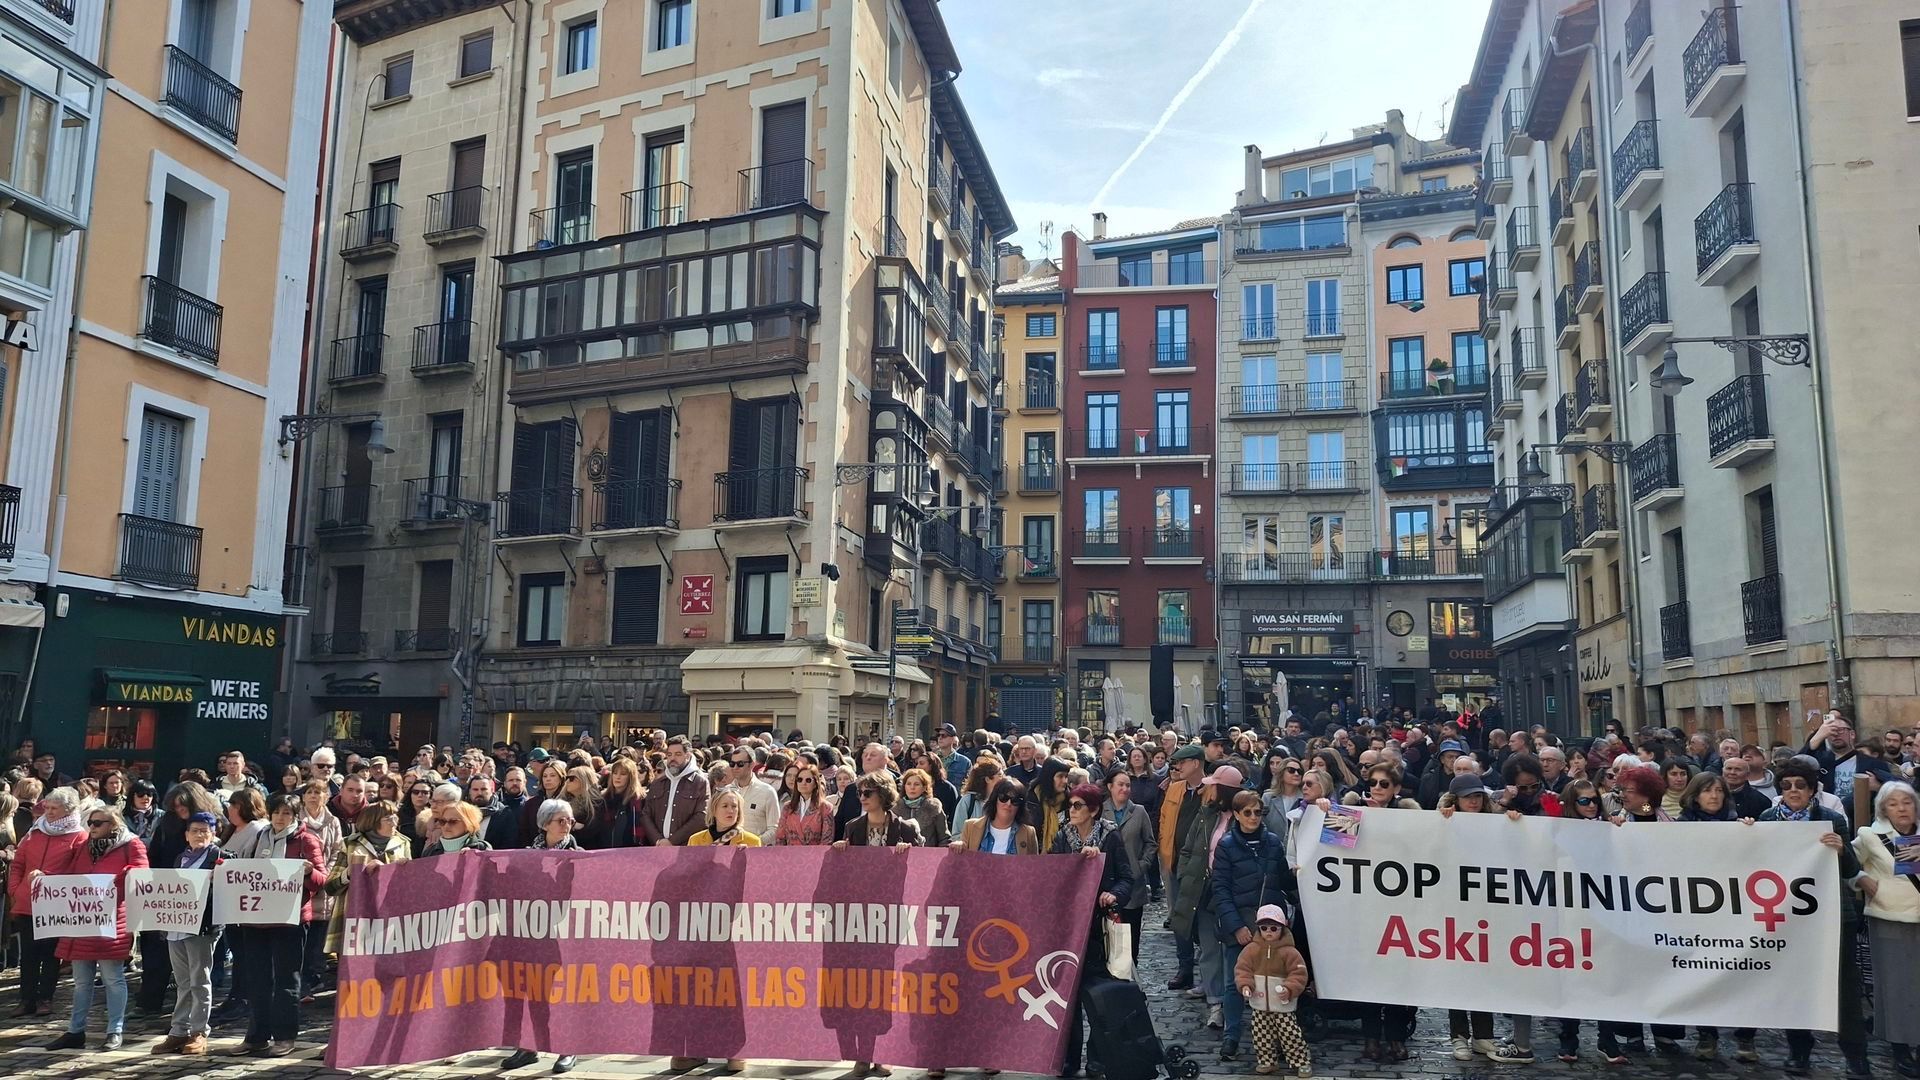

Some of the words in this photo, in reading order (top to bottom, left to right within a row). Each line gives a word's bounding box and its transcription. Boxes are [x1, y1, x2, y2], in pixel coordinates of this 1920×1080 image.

[0, 313, 39, 352] A
[1252, 614, 1277, 624] ¡VIVA
[1279, 614, 1301, 624] SAN
[1303, 612, 1343, 624] FERMÍN!
[183, 615, 276, 647] VIANDAS
[1397, 651, 1406, 662] 2
[120, 683, 193, 703] VIANDAS
[196, 701, 268, 720] FARMERS
[226, 870, 263, 885] ERASO
[1316, 856, 1441, 900] STOP
[135, 880, 153, 896] NO
[157, 883, 165, 894] A
[168, 883, 189, 895] LAS
[36, 915, 46, 928] EL
[342, 898, 507, 956] EMAKUMEON
[513, 898, 670, 941] KONTRAKO
[679, 900, 919, 947] INDARKERIARIK
[926, 905, 960, 947] EZ
[1376, 915, 1490, 963] Aski
[1509, 922, 1595, 971] da!
[1654, 933, 1744, 949] Plataforma
[1749, 936, 1787, 952] Stop
[1671, 956, 1772, 971] feminicidios
[338, 977, 383, 1019] NO
[441, 960, 600, 1008] VIOLENCIA
[609, 963, 737, 1008] CONTRA
[746, 967, 806, 1008] LAS
[816, 967, 959, 1015] MUJERES
